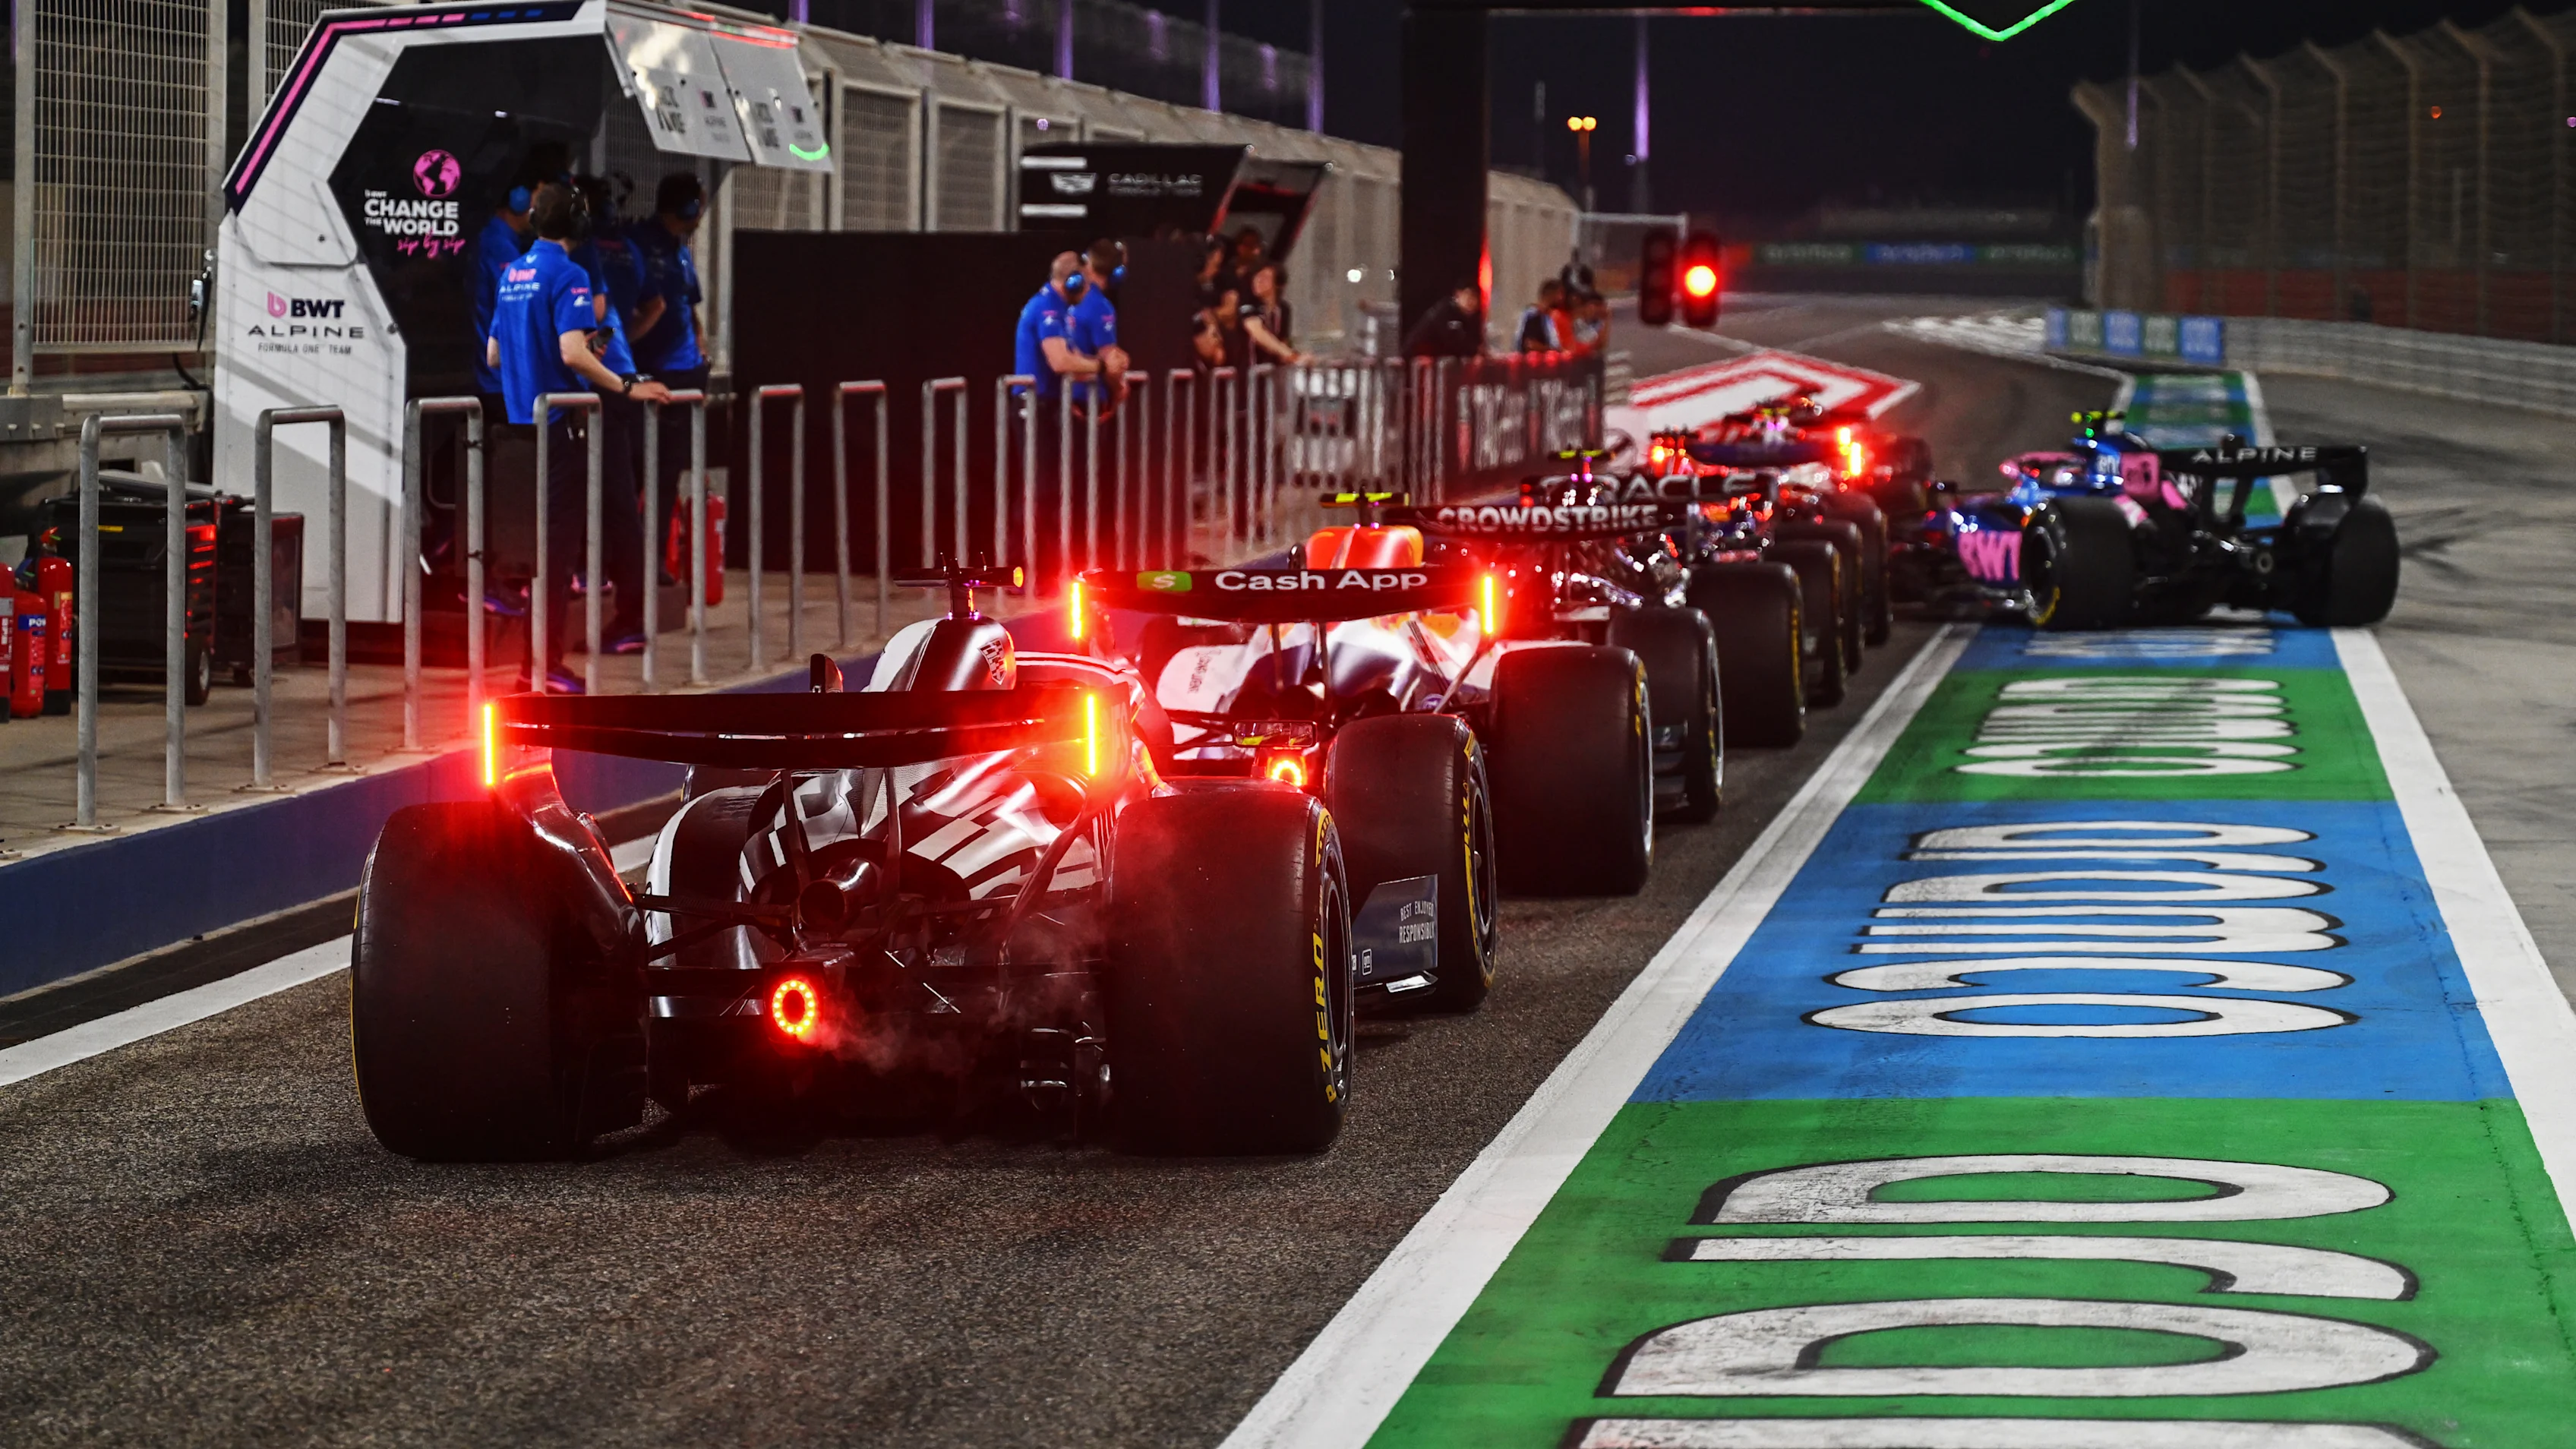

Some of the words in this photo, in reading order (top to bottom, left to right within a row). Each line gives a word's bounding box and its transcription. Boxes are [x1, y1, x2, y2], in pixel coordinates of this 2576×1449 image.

[364, 198, 459, 219] CHANGE
[365, 217, 382, 226] THE
[382, 217, 459, 237] WORLD
[291, 298, 345, 319] BWT
[248, 324, 365, 339] ALPINE
[257, 343, 298, 354] FORMULA
[328, 344, 352, 355] TEAM
[2191, 447, 2317, 464] ALPINE
[1436, 504, 1659, 532] CROWDSTRIKE
[1215, 570, 1325, 591] Cash
[1335, 570, 1428, 592] App
[1400, 902, 1413, 921] BEST
[1414, 901, 1435, 917] ENJOYED
[1399, 921, 1435, 943] RESPONSIBLY
[1800, 819, 2361, 1038] aramco
[1312, 932, 1331, 1073] ZERO
